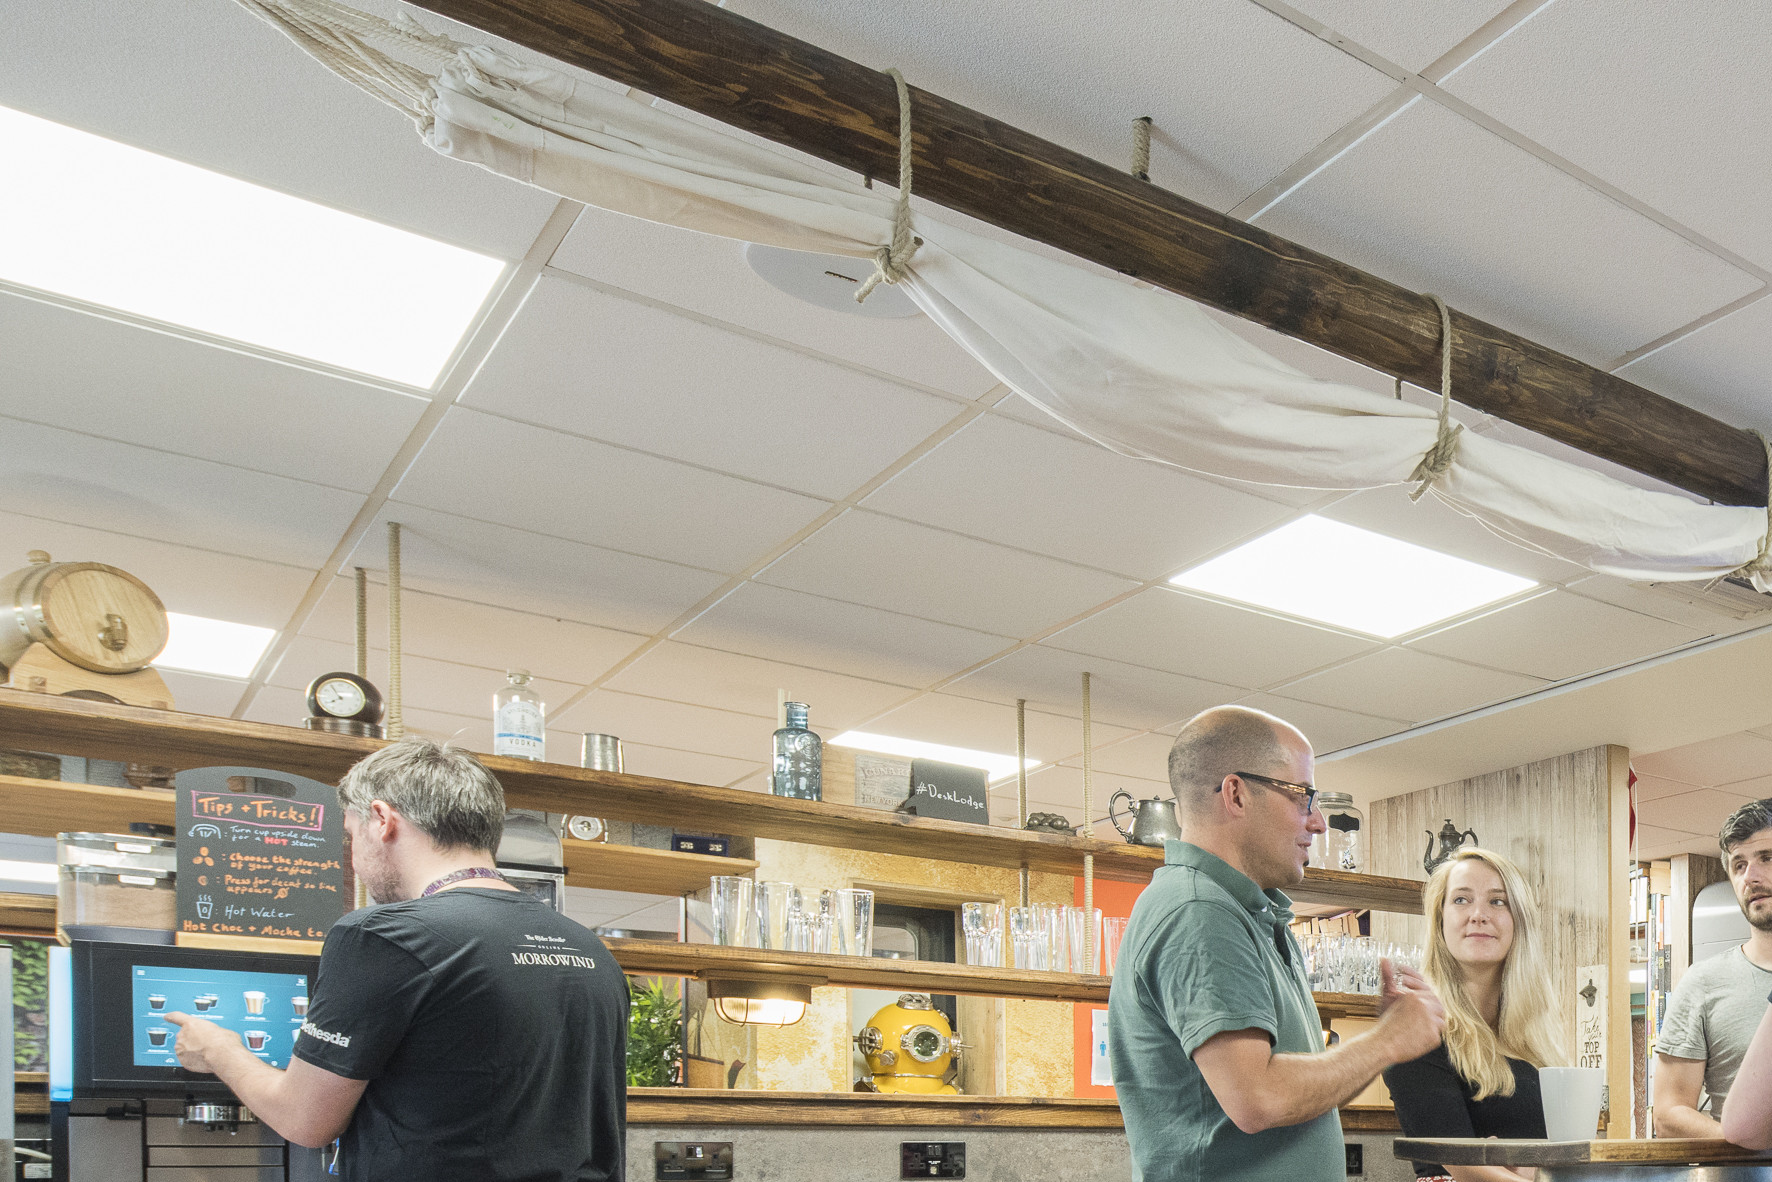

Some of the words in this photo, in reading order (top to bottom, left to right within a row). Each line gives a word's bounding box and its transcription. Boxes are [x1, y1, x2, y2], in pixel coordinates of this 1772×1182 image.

[510, 738, 536, 747] VODKA
[916, 782, 985, 810] #DeskLodge
[197, 796, 233, 816] Tips
[250, 800, 317, 827] Tricks!
[229, 825, 251, 833] Turn
[254, 829, 270, 837] cup
[271, 830, 299, 839] upside
[301, 832, 326, 842] down
[231, 834, 250, 842] for
[264, 836, 289, 846] HOT
[229, 852, 270, 864] Choose
[272, 854, 292, 865] the
[293, 856, 341, 870] strength
[230, 860, 244, 870] of
[248, 862, 274, 872] your
[224, 874, 251, 886] Press
[252, 876, 270, 889] for
[271, 876, 302, 889] decaf
[303, 881, 316, 890] so
[318, 881, 338, 893] line
[226, 885, 273, 895] appears
[224, 904, 247, 920] Hot
[250, 907, 295, 919] Water
[183, 920, 207, 932] Hot
[212, 923, 244, 933] Choc
[260, 925, 302, 938] Mocha
[511, 952, 596, 969] MORROWIND
[1584, 1041, 1600, 1053] TOP
[1580, 1054, 1602, 1068] OFF
